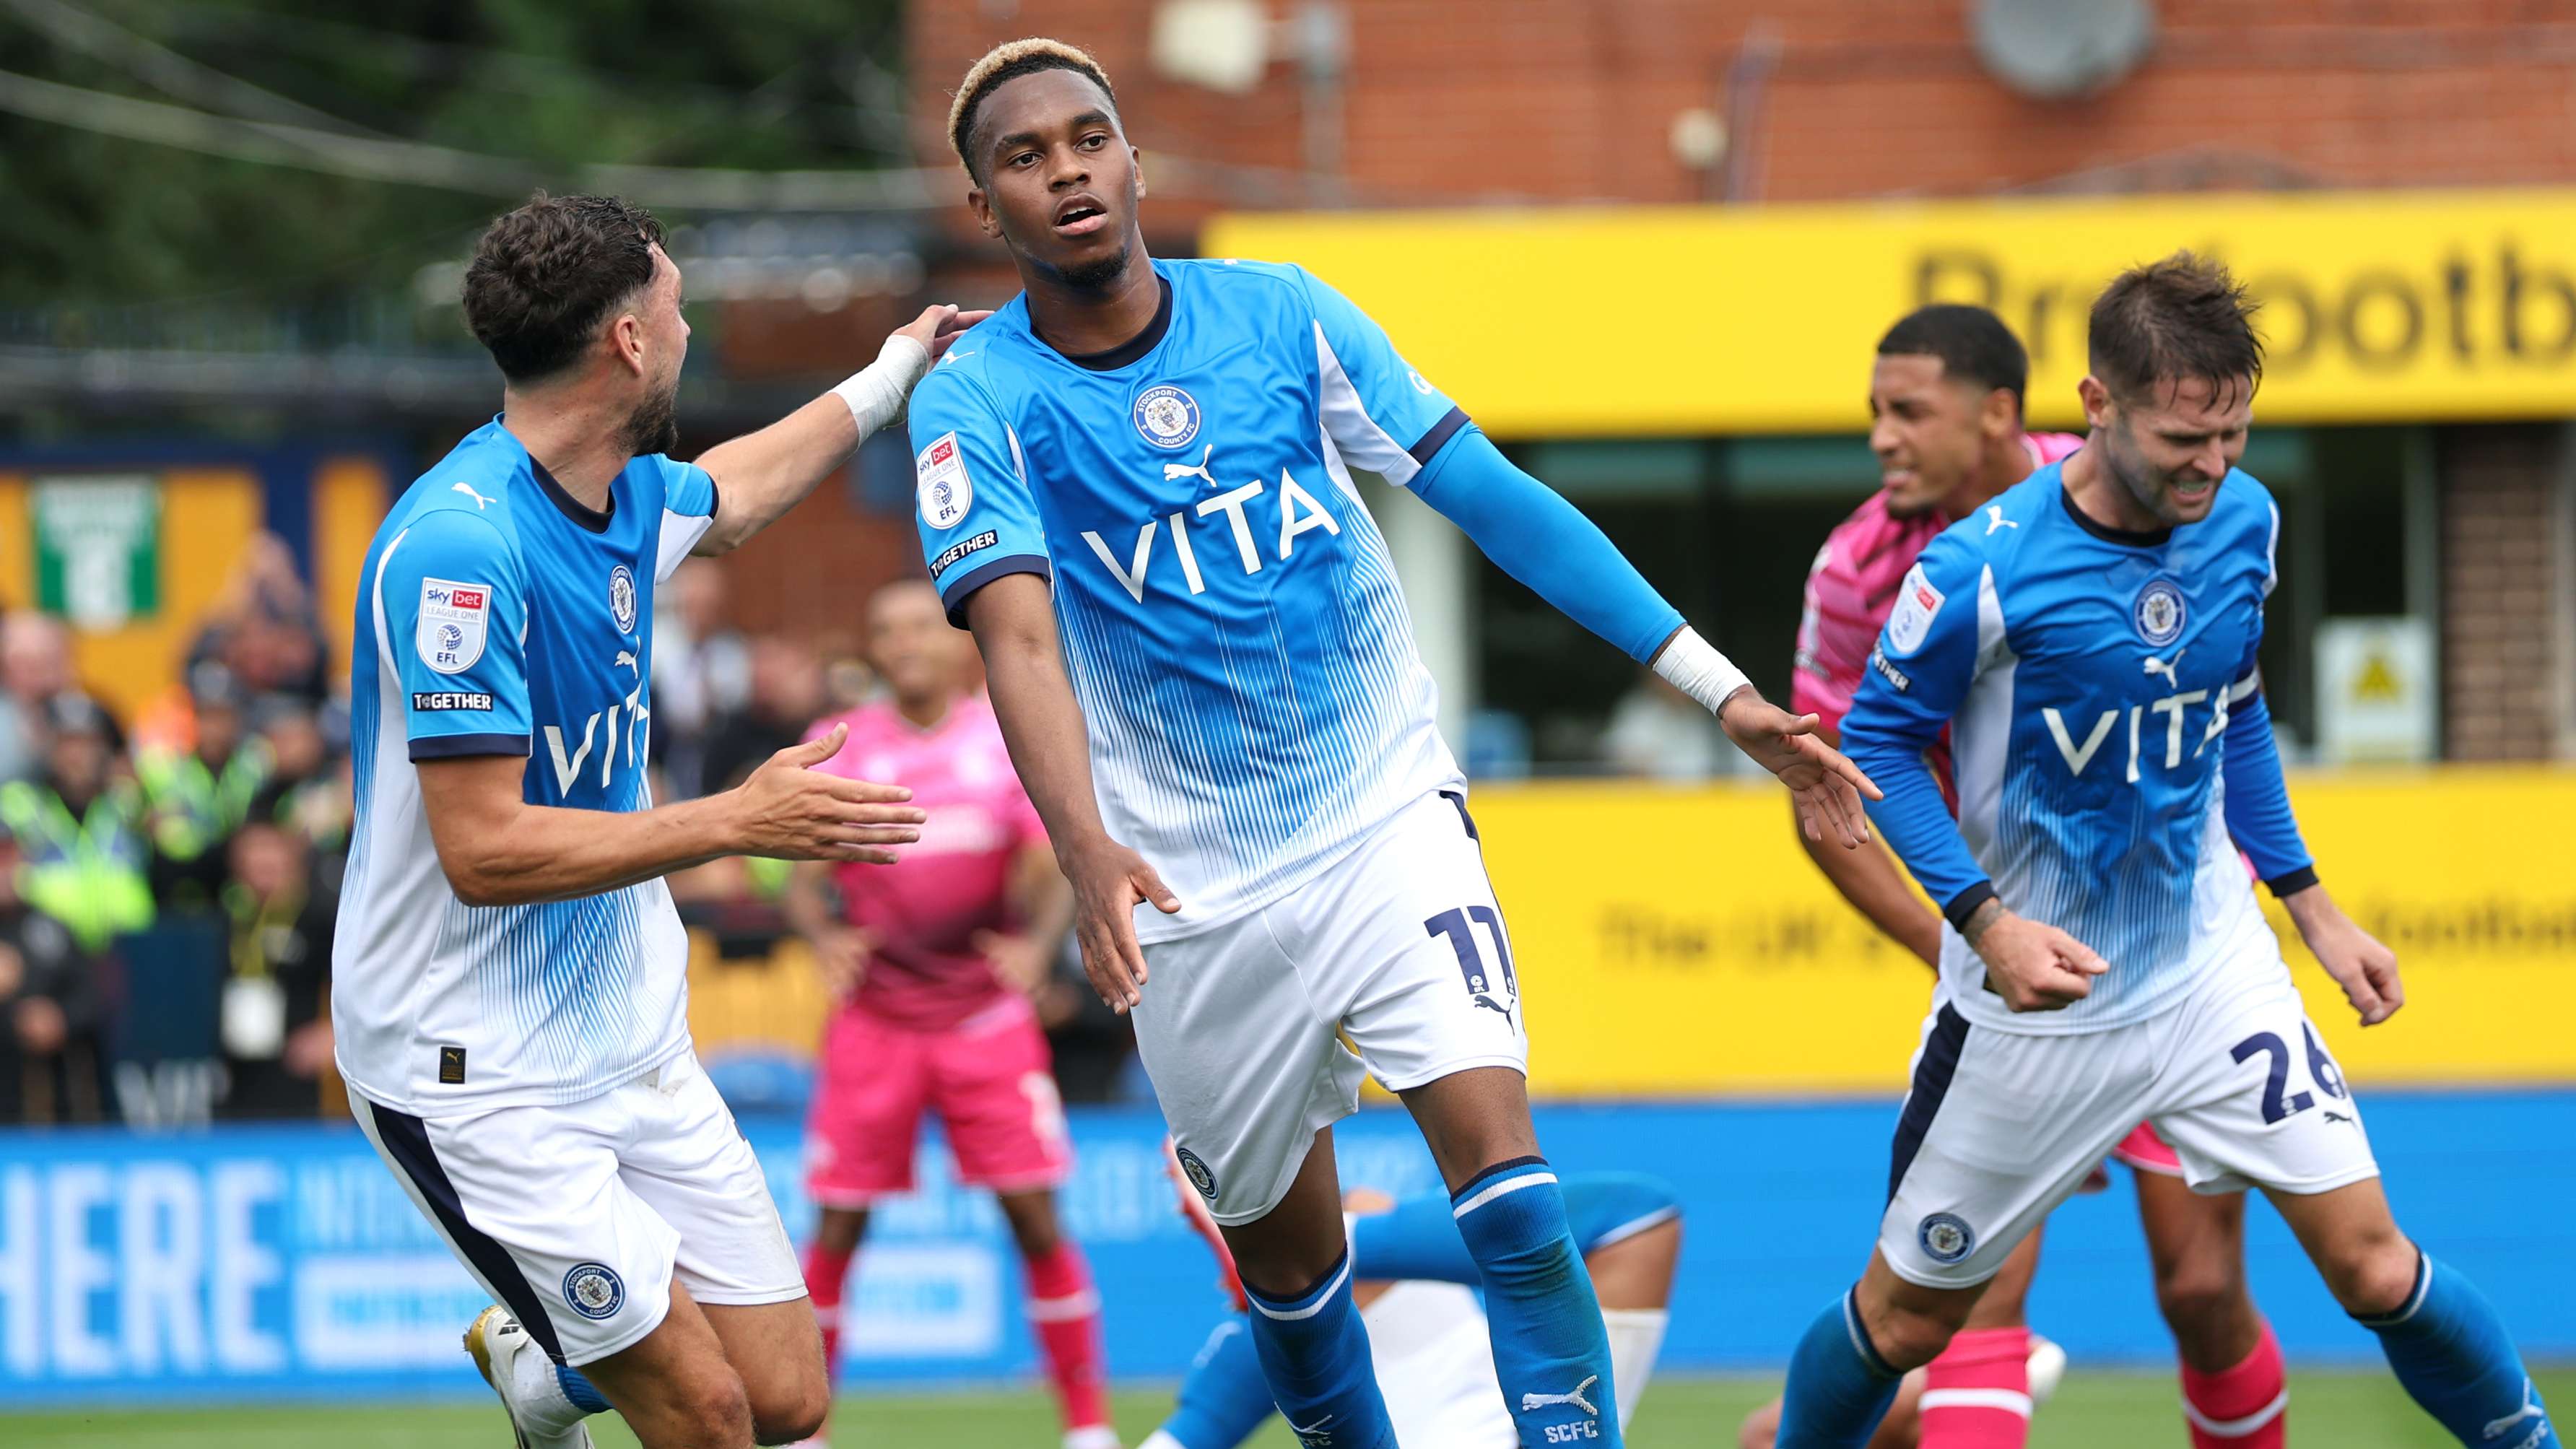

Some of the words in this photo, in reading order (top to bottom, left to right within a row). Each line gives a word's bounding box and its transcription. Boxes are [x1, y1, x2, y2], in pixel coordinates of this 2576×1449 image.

[1138, 390, 1177, 413] STOCKPORT
[1158, 432, 1188, 444] COUNTY
[1186, 423, 1195, 432] FC
[919, 456, 931, 474] sky
[932, 443, 951, 461] bet
[921, 466, 941, 485] LEAGUE
[942, 458, 956, 471] ONE
[939, 505, 957, 520] EFL
[1080, 466, 1341, 604] VITA
[427, 588, 451, 604] sky
[455, 591, 480, 606] bet
[427, 606, 458, 619] LEAGUE
[461, 611, 479, 620] ONE
[437, 652, 458, 664] EFL
[544, 679, 649, 799] VIT
[1424, 905, 1516, 997] 11
[2230, 1020, 2346, 1125] 26
[569, 1269, 601, 1289] STOCKPORT
[1544, 1420, 1598, 1443] SCFC
